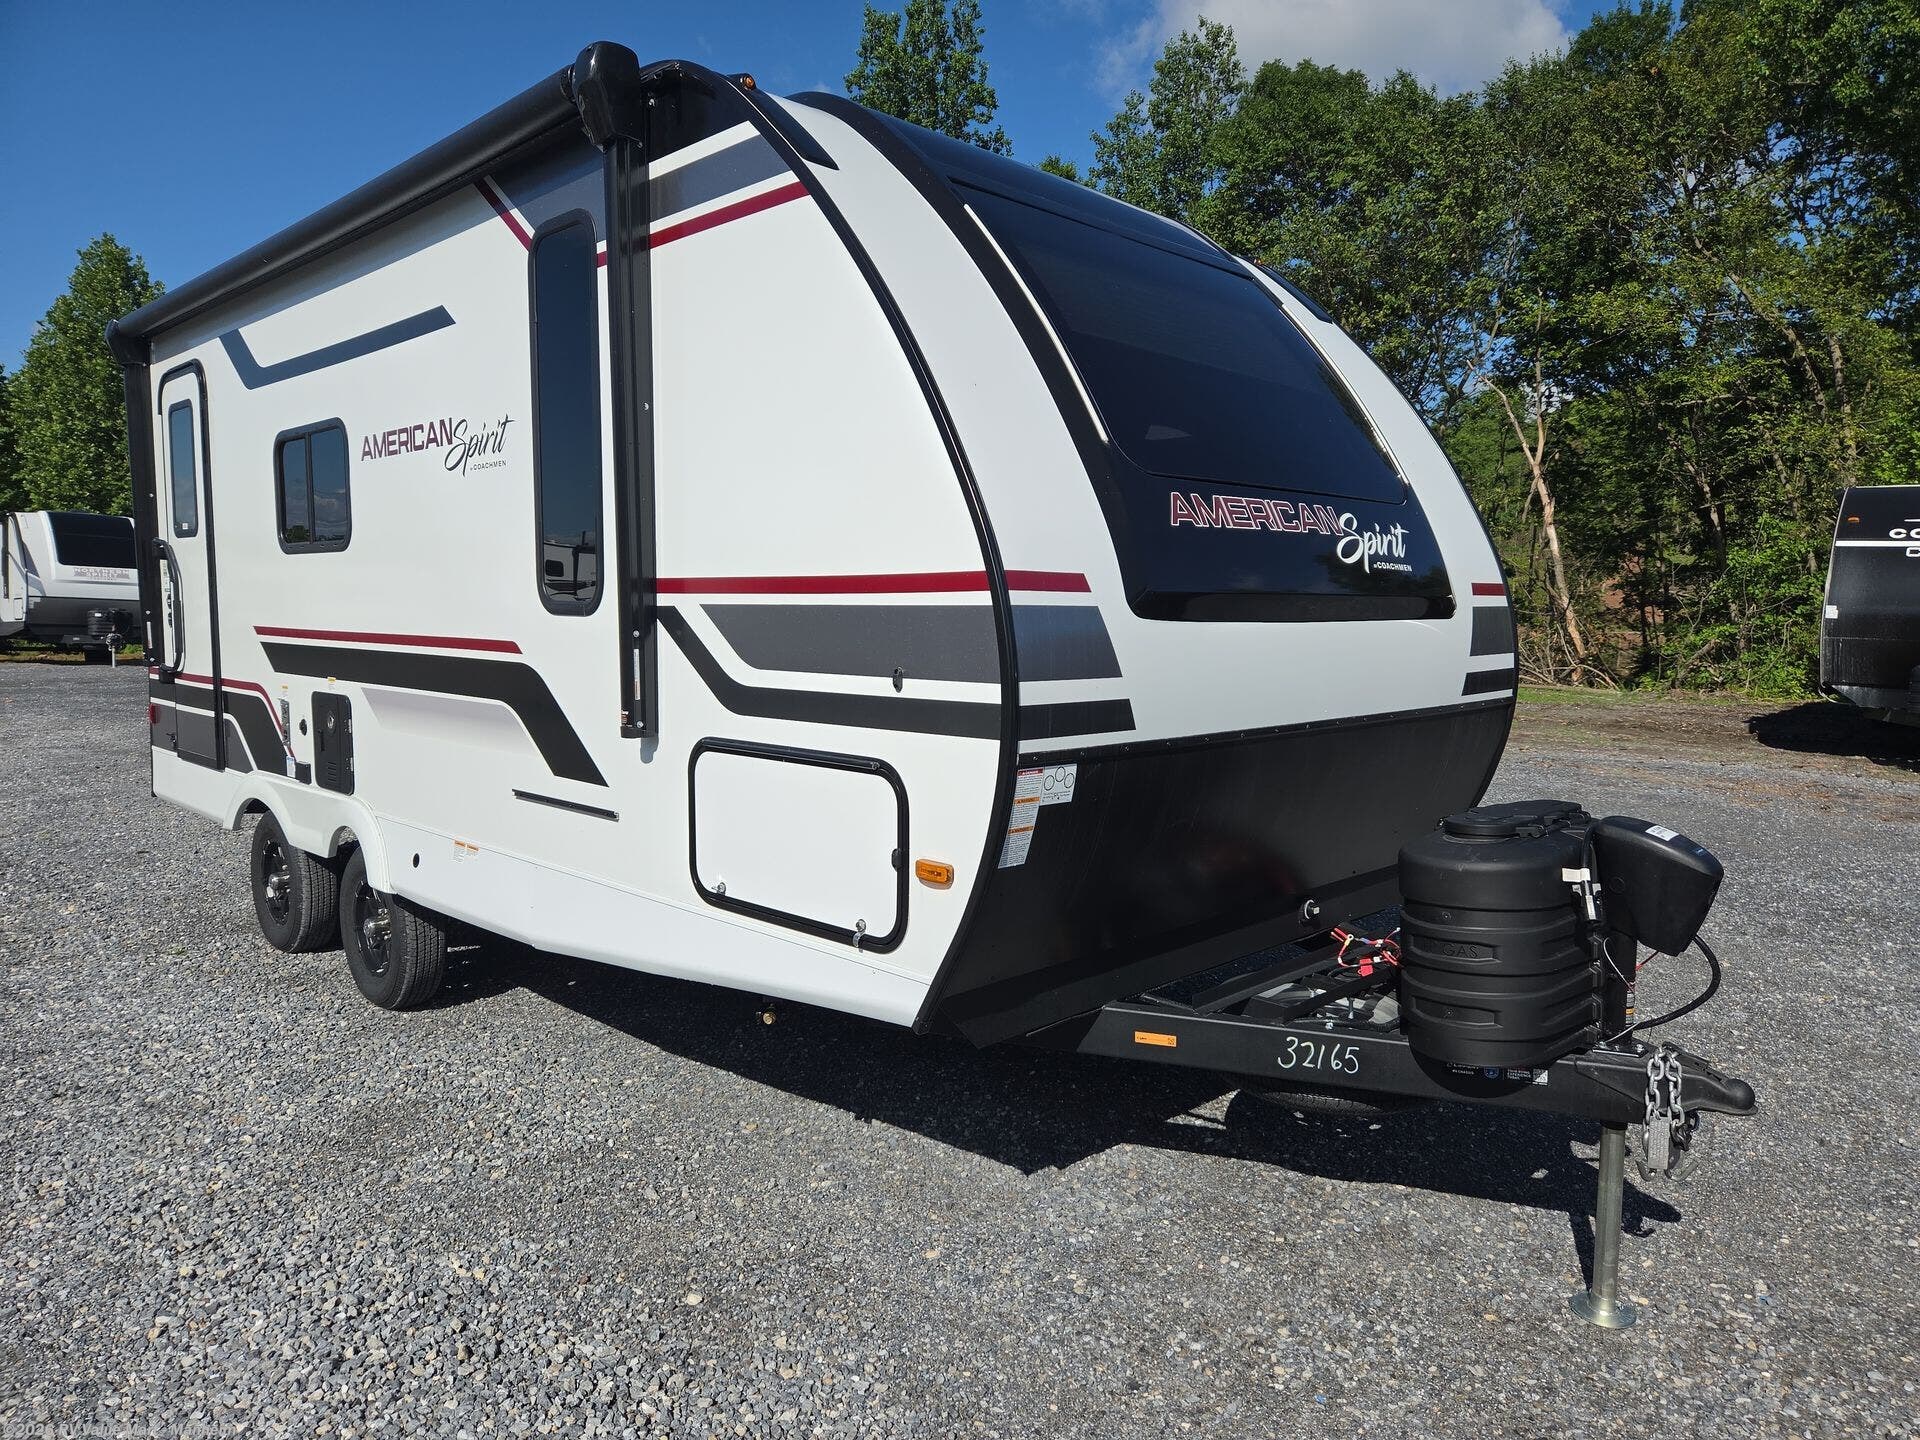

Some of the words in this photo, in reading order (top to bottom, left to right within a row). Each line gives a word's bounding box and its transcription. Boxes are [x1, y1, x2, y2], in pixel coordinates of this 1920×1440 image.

[361, 417, 453, 462] AMERICAN
[443, 414, 516, 477] Spirit
[472, 460, 507, 470] COACHMEN
[1170, 491, 1344, 536] AMERICAN
[1336, 512, 1410, 574] Spirit
[1377, 562, 1412, 572] COACHMEN
[1442, 943, 1479, 959] GAS
[1277, 1036, 1360, 1074] 32165
